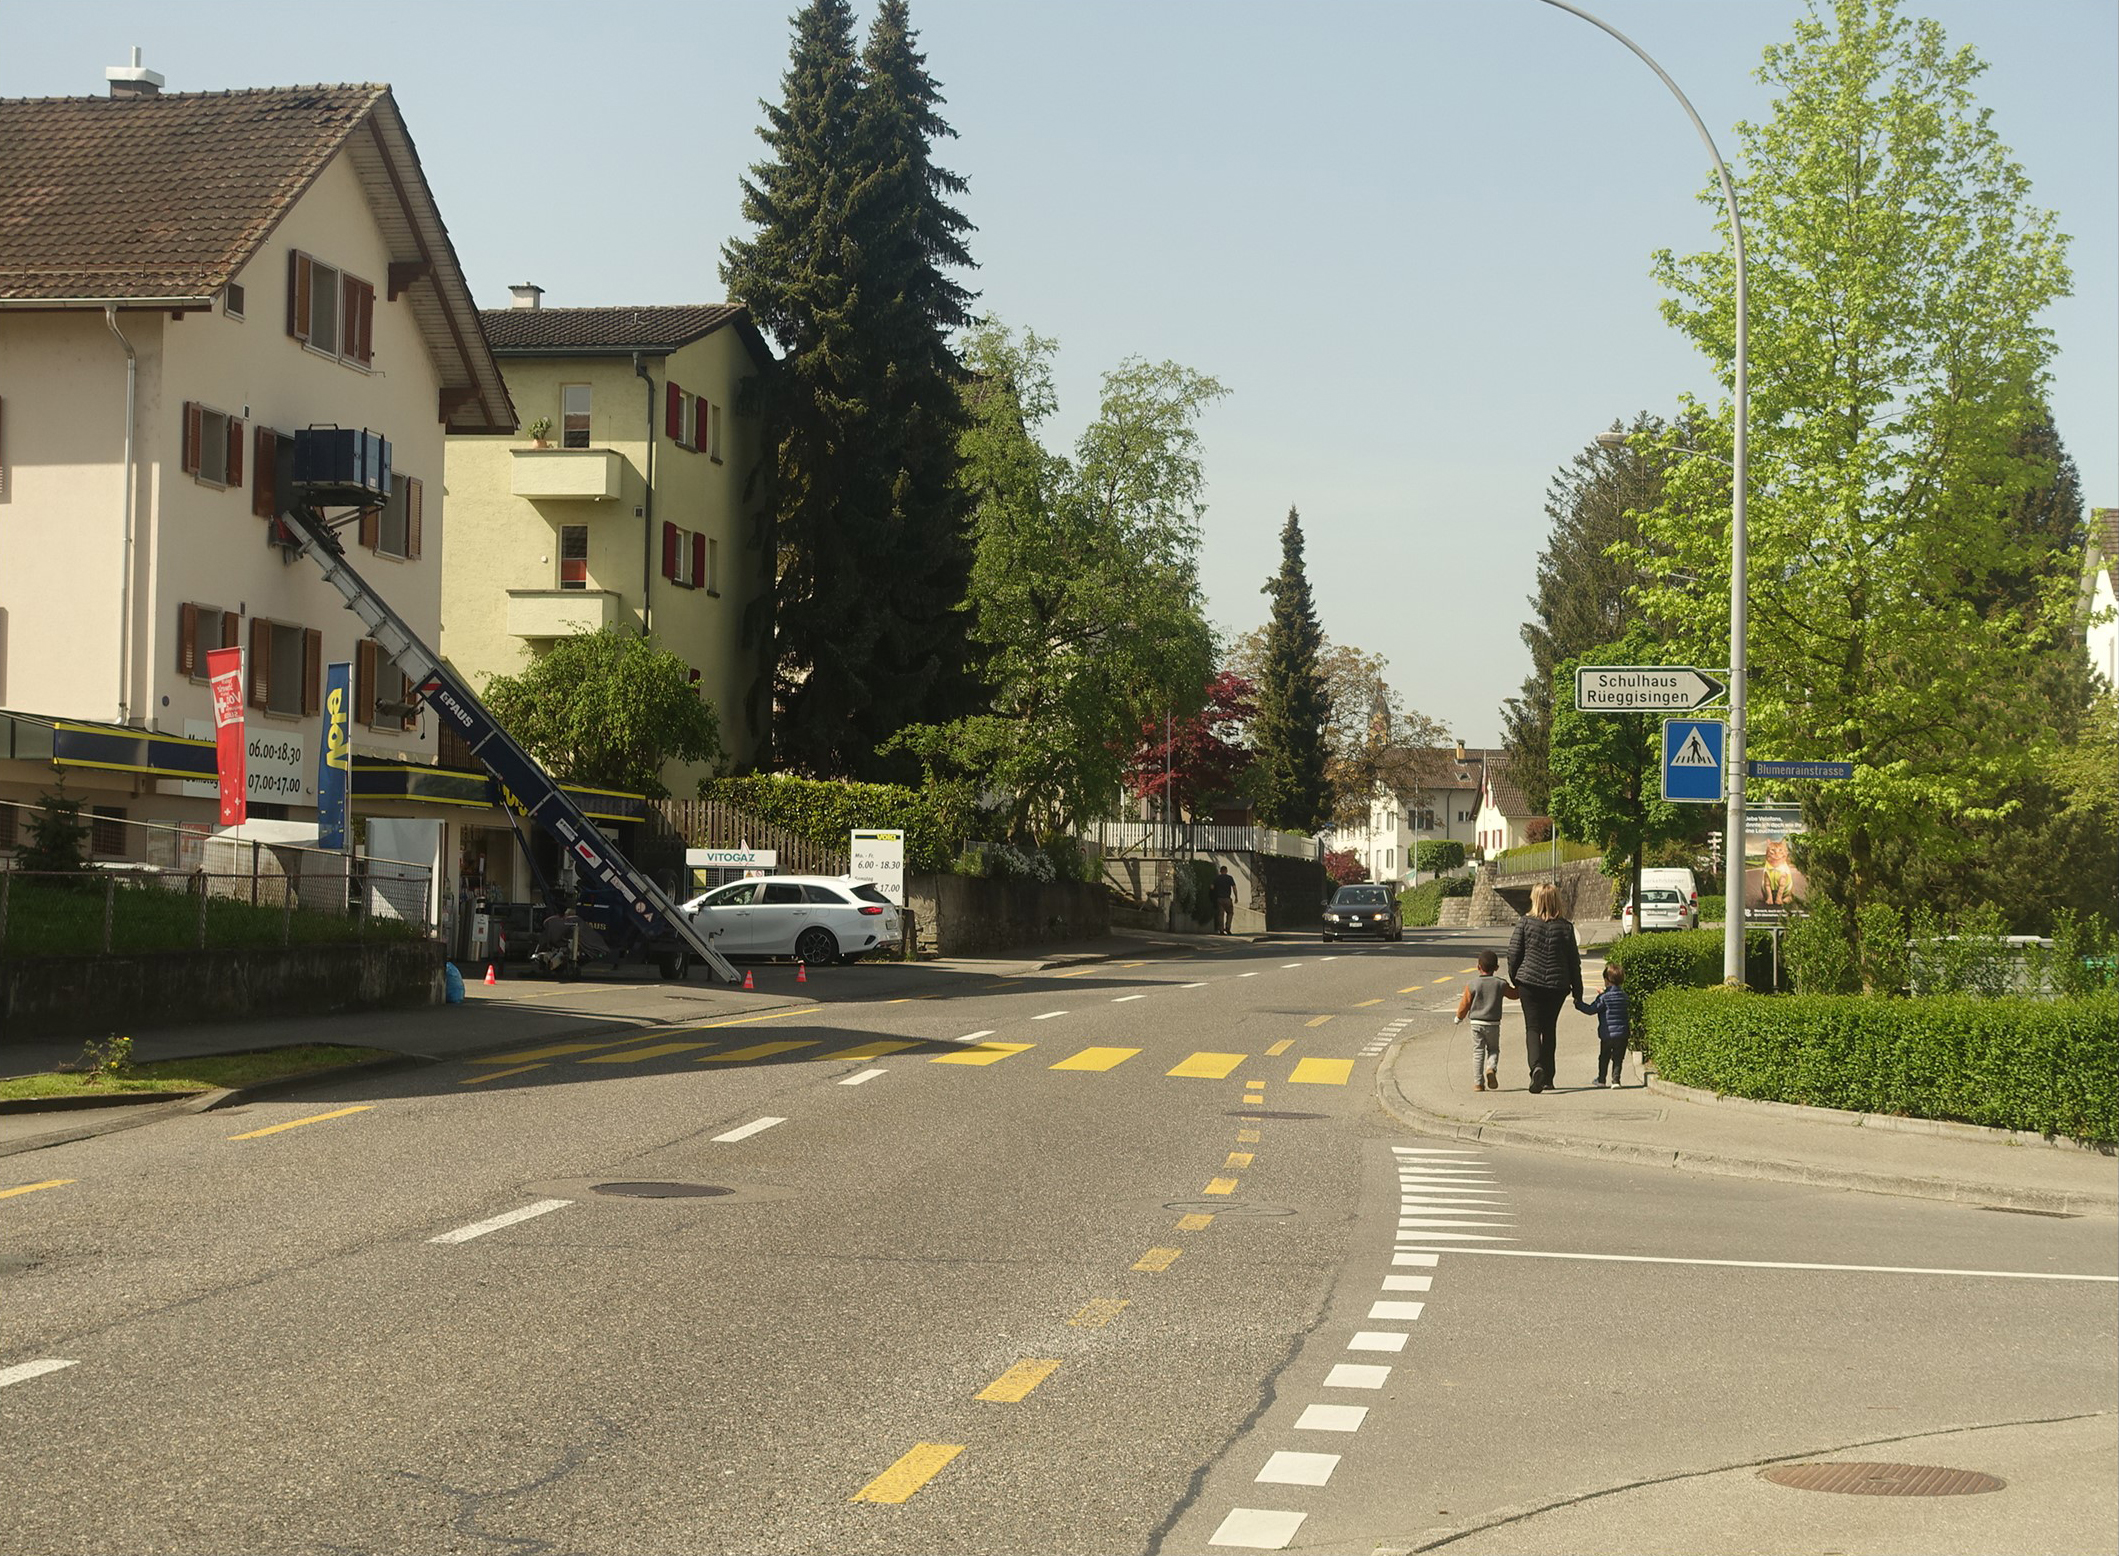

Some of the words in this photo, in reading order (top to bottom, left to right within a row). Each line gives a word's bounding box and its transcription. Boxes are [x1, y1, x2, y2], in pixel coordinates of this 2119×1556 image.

[1598, 674, 1678, 687] Schulhaus
[1587, 689, 1689, 706] Rüeggisingen
[249, 738, 301, 766] 06.00-18.30
[1756, 763, 1845, 776] Blumenrainstrasse
[248, 774, 301, 796] 07.00-17.00
[857, 860, 875, 869] 6.00
[880, 861, 901, 870] 18.30
[880, 883, 901, 892] 17.00
